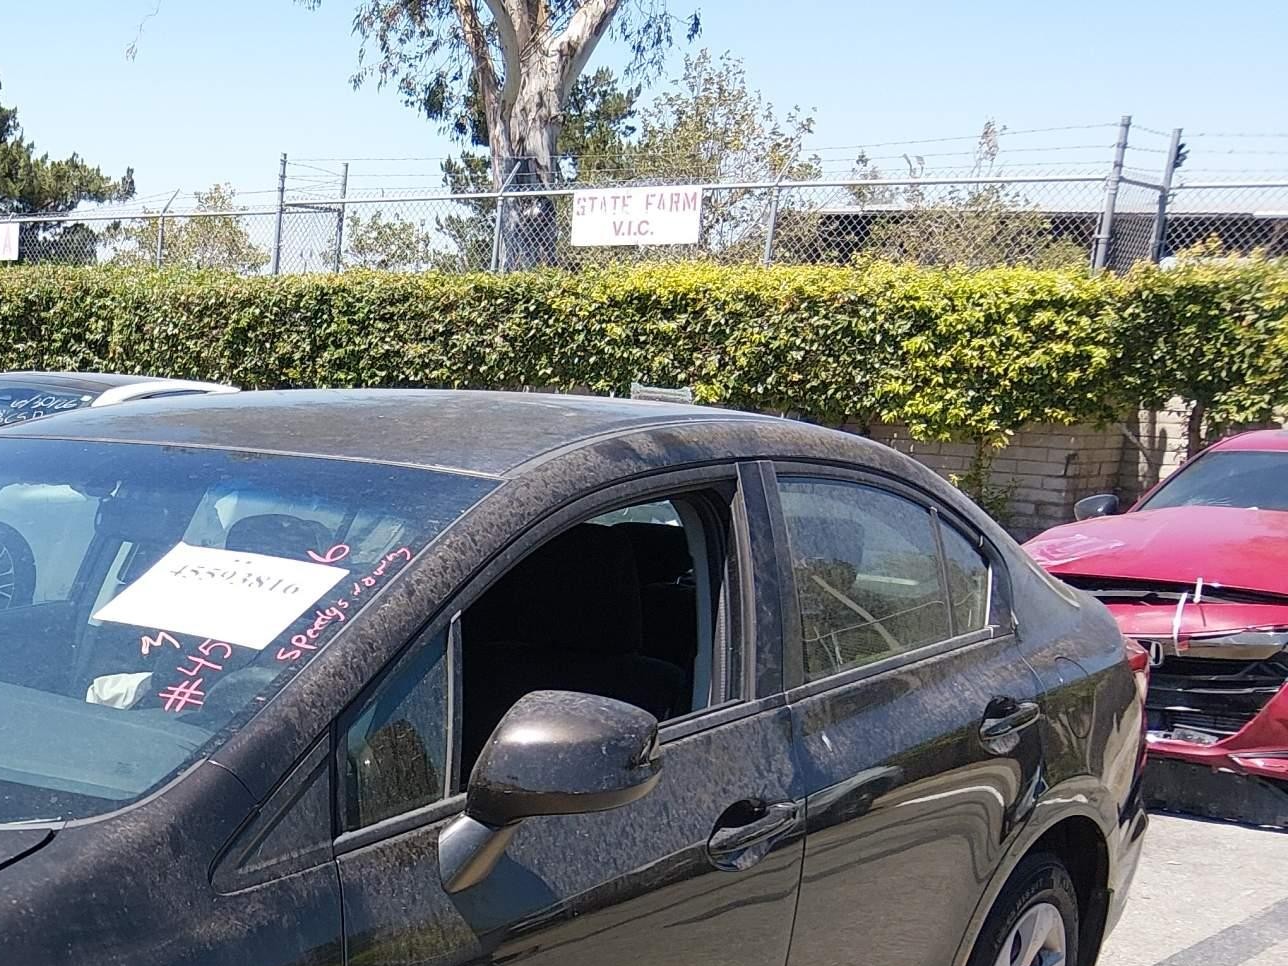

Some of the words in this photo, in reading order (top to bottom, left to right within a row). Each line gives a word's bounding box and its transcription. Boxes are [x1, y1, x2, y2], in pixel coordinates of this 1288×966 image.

[576, 194, 633, 216] STATE
[645, 190, 698, 213] FARM
[612, 220, 655, 237] V.I.C.
